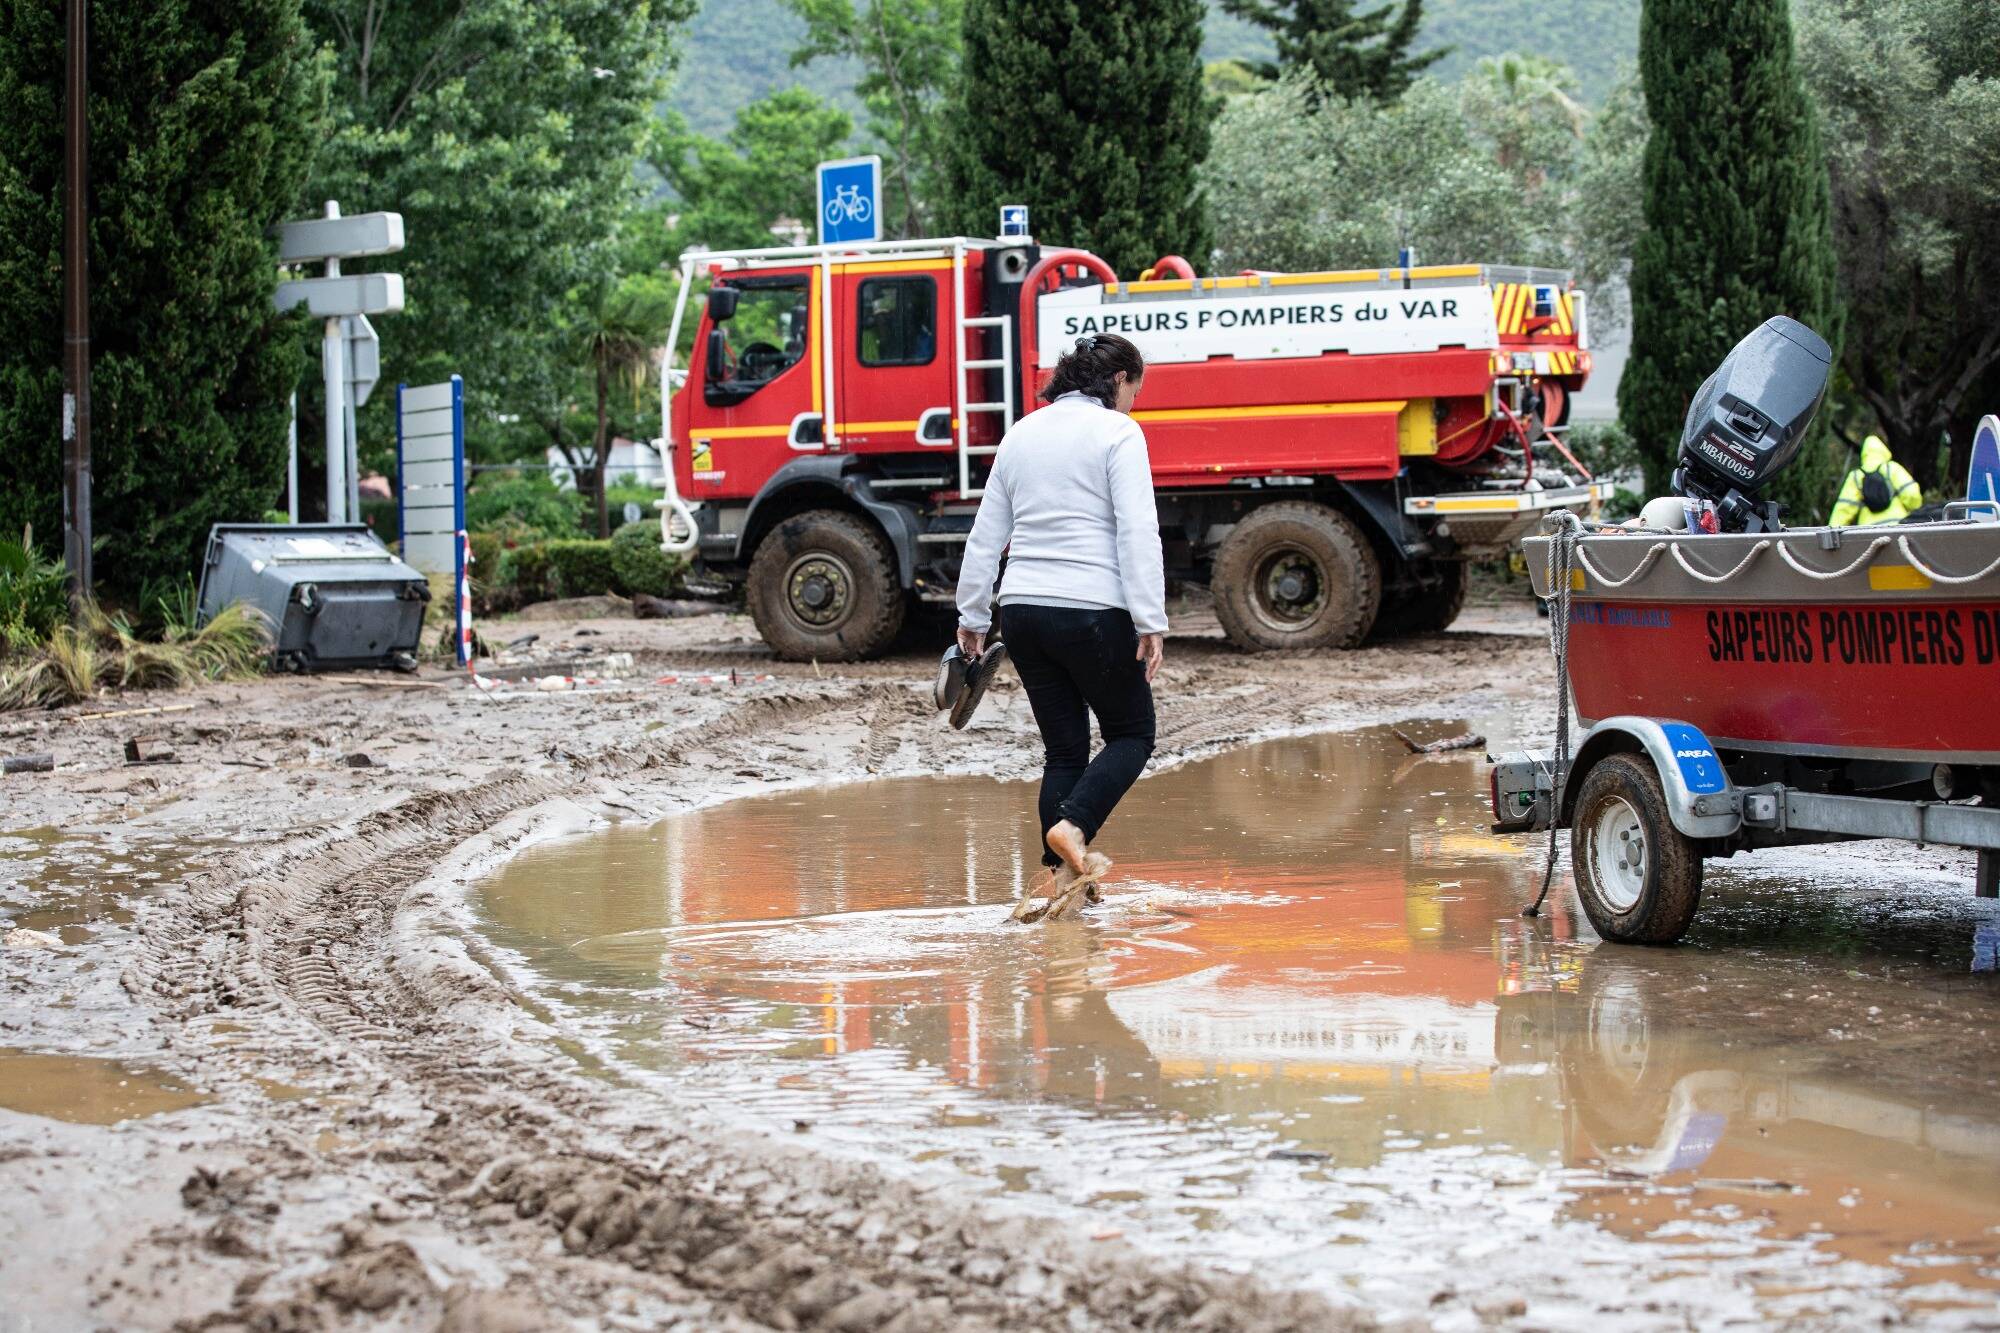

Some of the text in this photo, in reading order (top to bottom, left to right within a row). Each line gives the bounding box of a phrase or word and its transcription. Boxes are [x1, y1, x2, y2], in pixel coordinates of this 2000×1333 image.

[1065, 299, 1458, 335] SAPEURS POMPIERS du VAR
[1700, 440, 1755, 479] MBAT0059
[1728, 440, 1757, 461] 25
[1706, 610, 2000, 666] SAPEURS POMPIERS D
[1677, 749, 1712, 758] AREA
